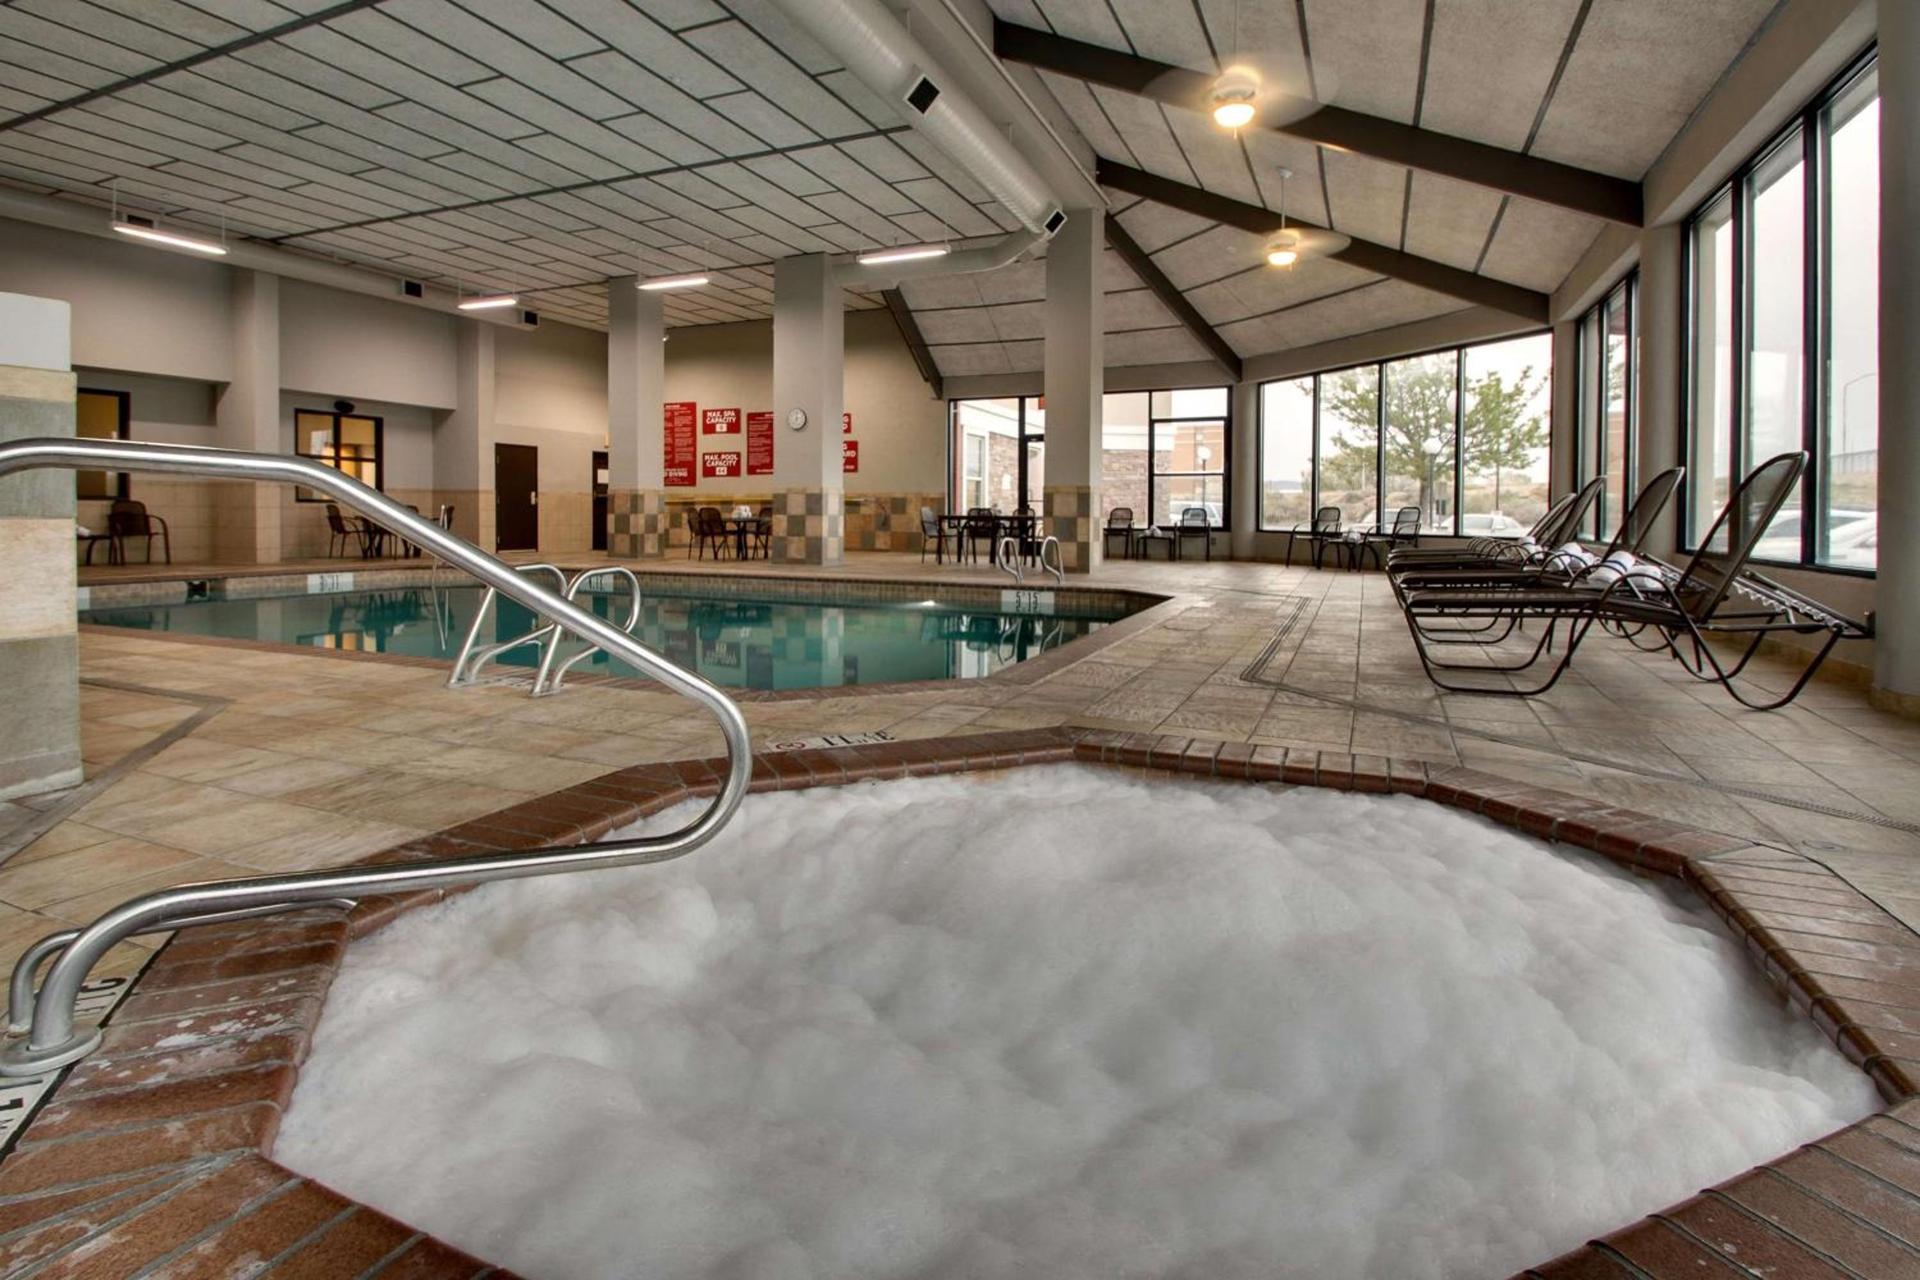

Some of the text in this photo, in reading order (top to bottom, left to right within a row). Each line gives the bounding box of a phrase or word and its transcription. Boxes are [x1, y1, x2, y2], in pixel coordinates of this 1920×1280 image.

[706, 416, 736, 424] CAPACITY
[720, 453, 738, 461] POOL
[706, 460, 736, 468] CAPACITY
